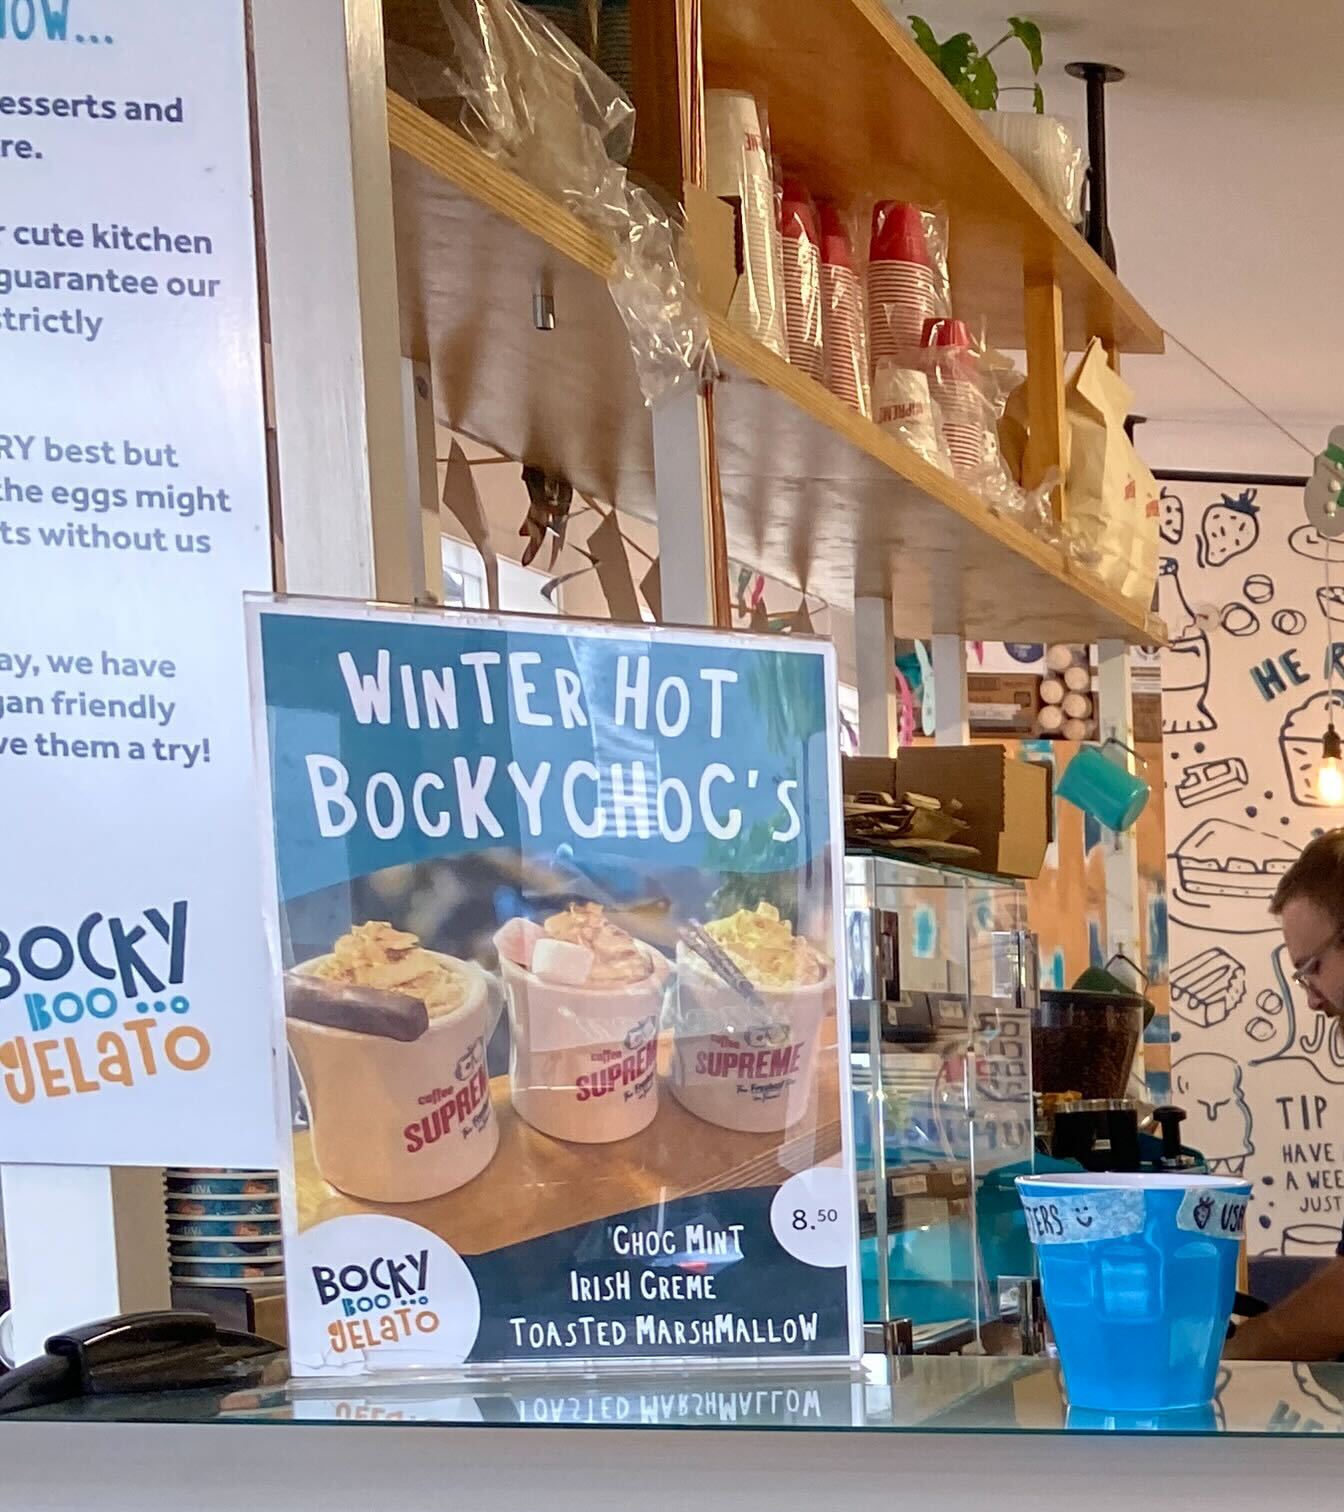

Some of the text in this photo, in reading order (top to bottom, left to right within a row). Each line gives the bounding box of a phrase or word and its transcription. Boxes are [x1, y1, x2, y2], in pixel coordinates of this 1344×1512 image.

[125, 98, 182, 123] and
[13, 222, 212, 254] cute kitchen
[0, 268, 220, 298] guarantee our
[0, 309, 103, 341] trictly
[44, 440, 179, 468] best but
[51, 484, 231, 518] eggs might
[38, 523, 211, 554] without us
[47, 651, 177, 678] we have
[1250, 648, 1311, 700] HE
[51, 692, 176, 726] friendly
[338, 649, 739, 738] WINTER HOT
[35, 733, 212, 768] them try!
[305, 754, 800, 843] BOCKYCHOC'S
[695, 1041, 803, 1078] SUPREME
[1276, 1095, 1328, 1130] TIP
[1282, 1143, 1336, 1163] HAVE
[1299, 1194, 1341, 1214] JUST
[614, 1224, 745, 1257] CHOC MINT
[313, 1250, 429, 1305] BOCKY
[570, 1271, 717, 1301] IRISH CREME
[510, 1313, 819, 1347] TOASTED MARSHMALLOW
